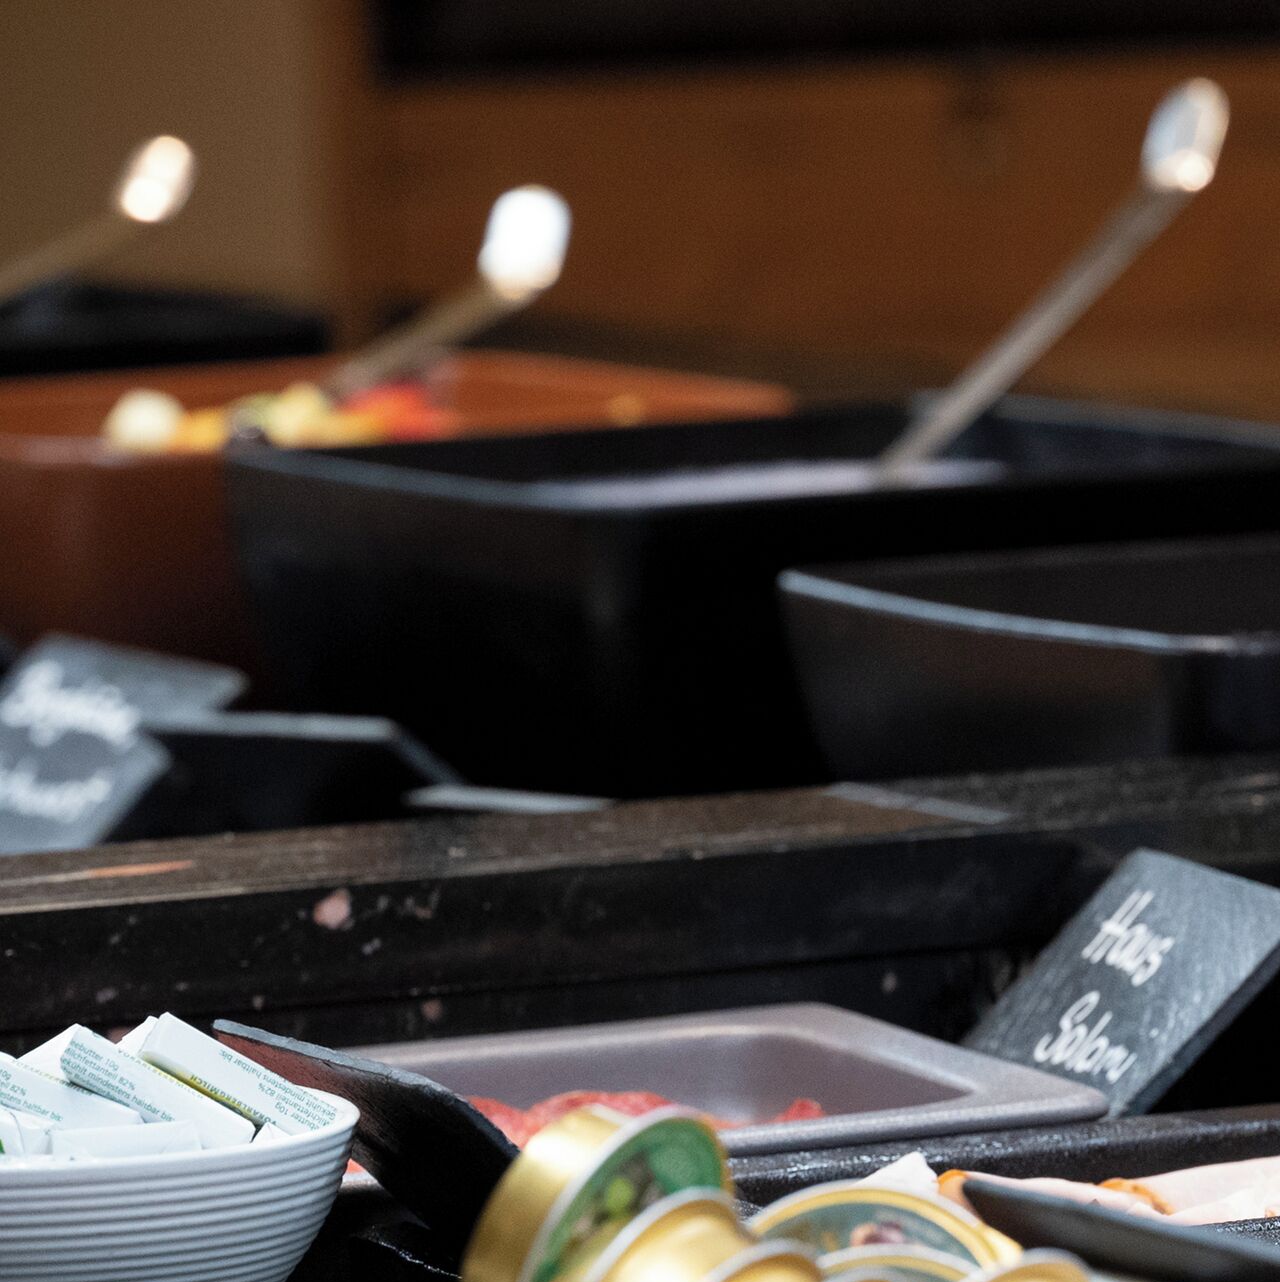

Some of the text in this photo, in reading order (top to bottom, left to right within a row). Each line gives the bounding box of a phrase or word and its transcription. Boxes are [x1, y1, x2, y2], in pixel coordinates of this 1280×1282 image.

[1081, 889, 1176, 986] Haus
[233, 1057, 261, 1078] haltbar
[88, 1071, 131, 1099] mindestens
[132, 1095, 159, 1115] haltbar
[257, 1082, 275, 1096] 82%
[262, 1074, 304, 1103] mindestens
[274, 1102, 289, 1114] 10g
